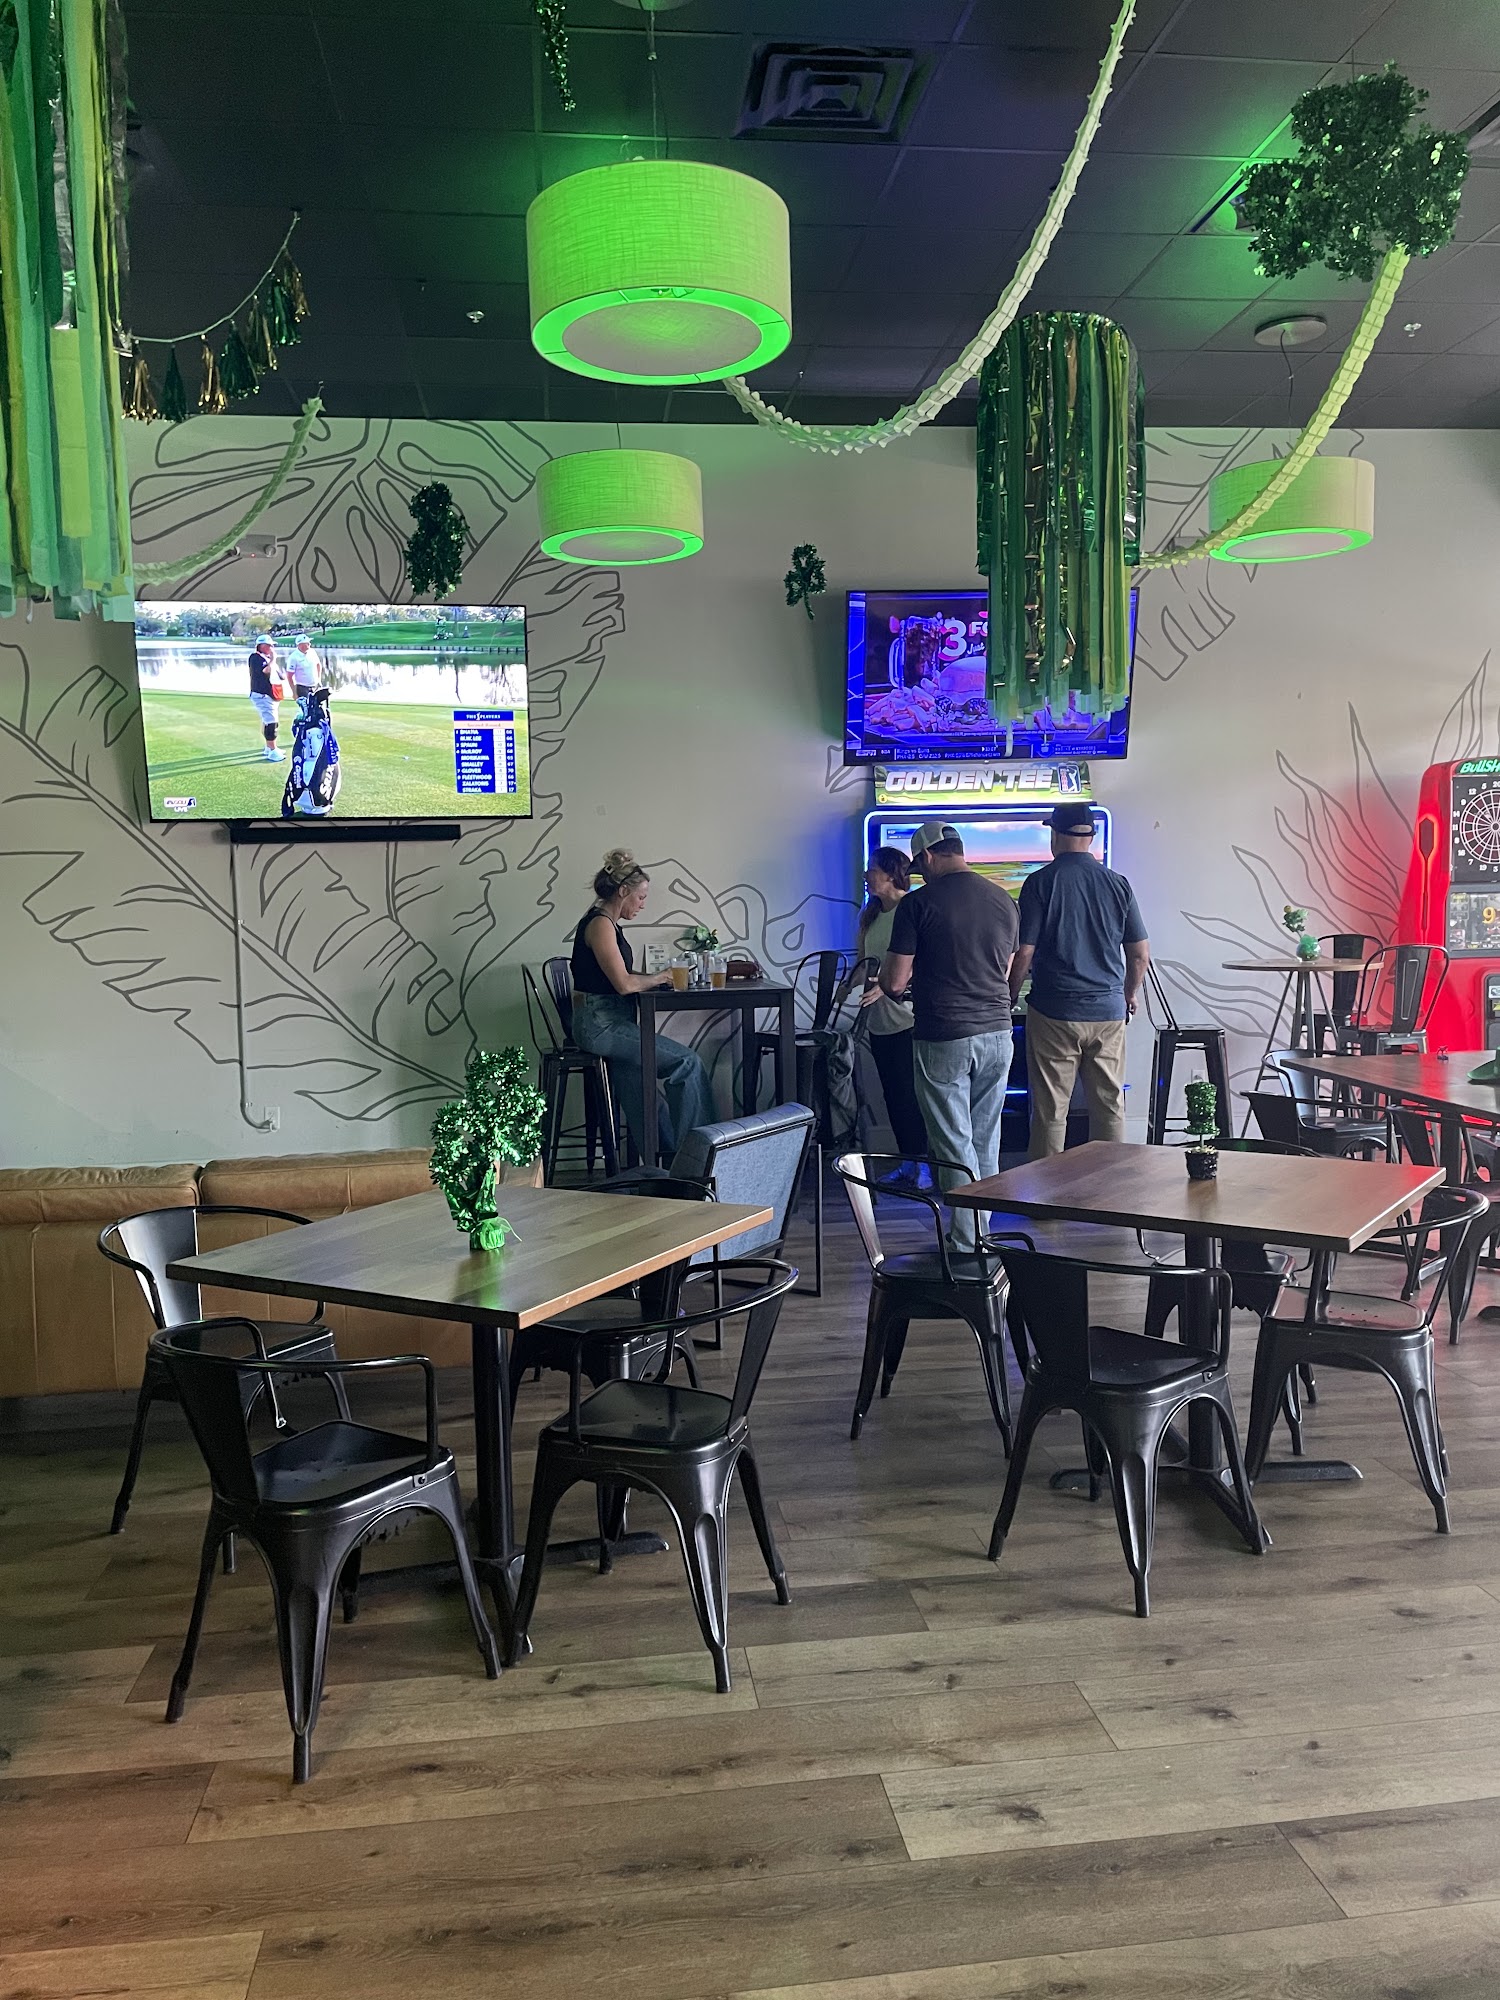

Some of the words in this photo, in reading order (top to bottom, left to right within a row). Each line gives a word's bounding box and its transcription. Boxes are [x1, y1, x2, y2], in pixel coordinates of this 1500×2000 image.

[942, 619, 967, 657] 3
[885, 770, 995, 791] GOLDEN
[1003, 769, 1053, 789] TEE
[1468, 788, 1477, 796] 12
[1467, 858, 1474, 866] 7
[1482, 906, 1496, 925] 9
